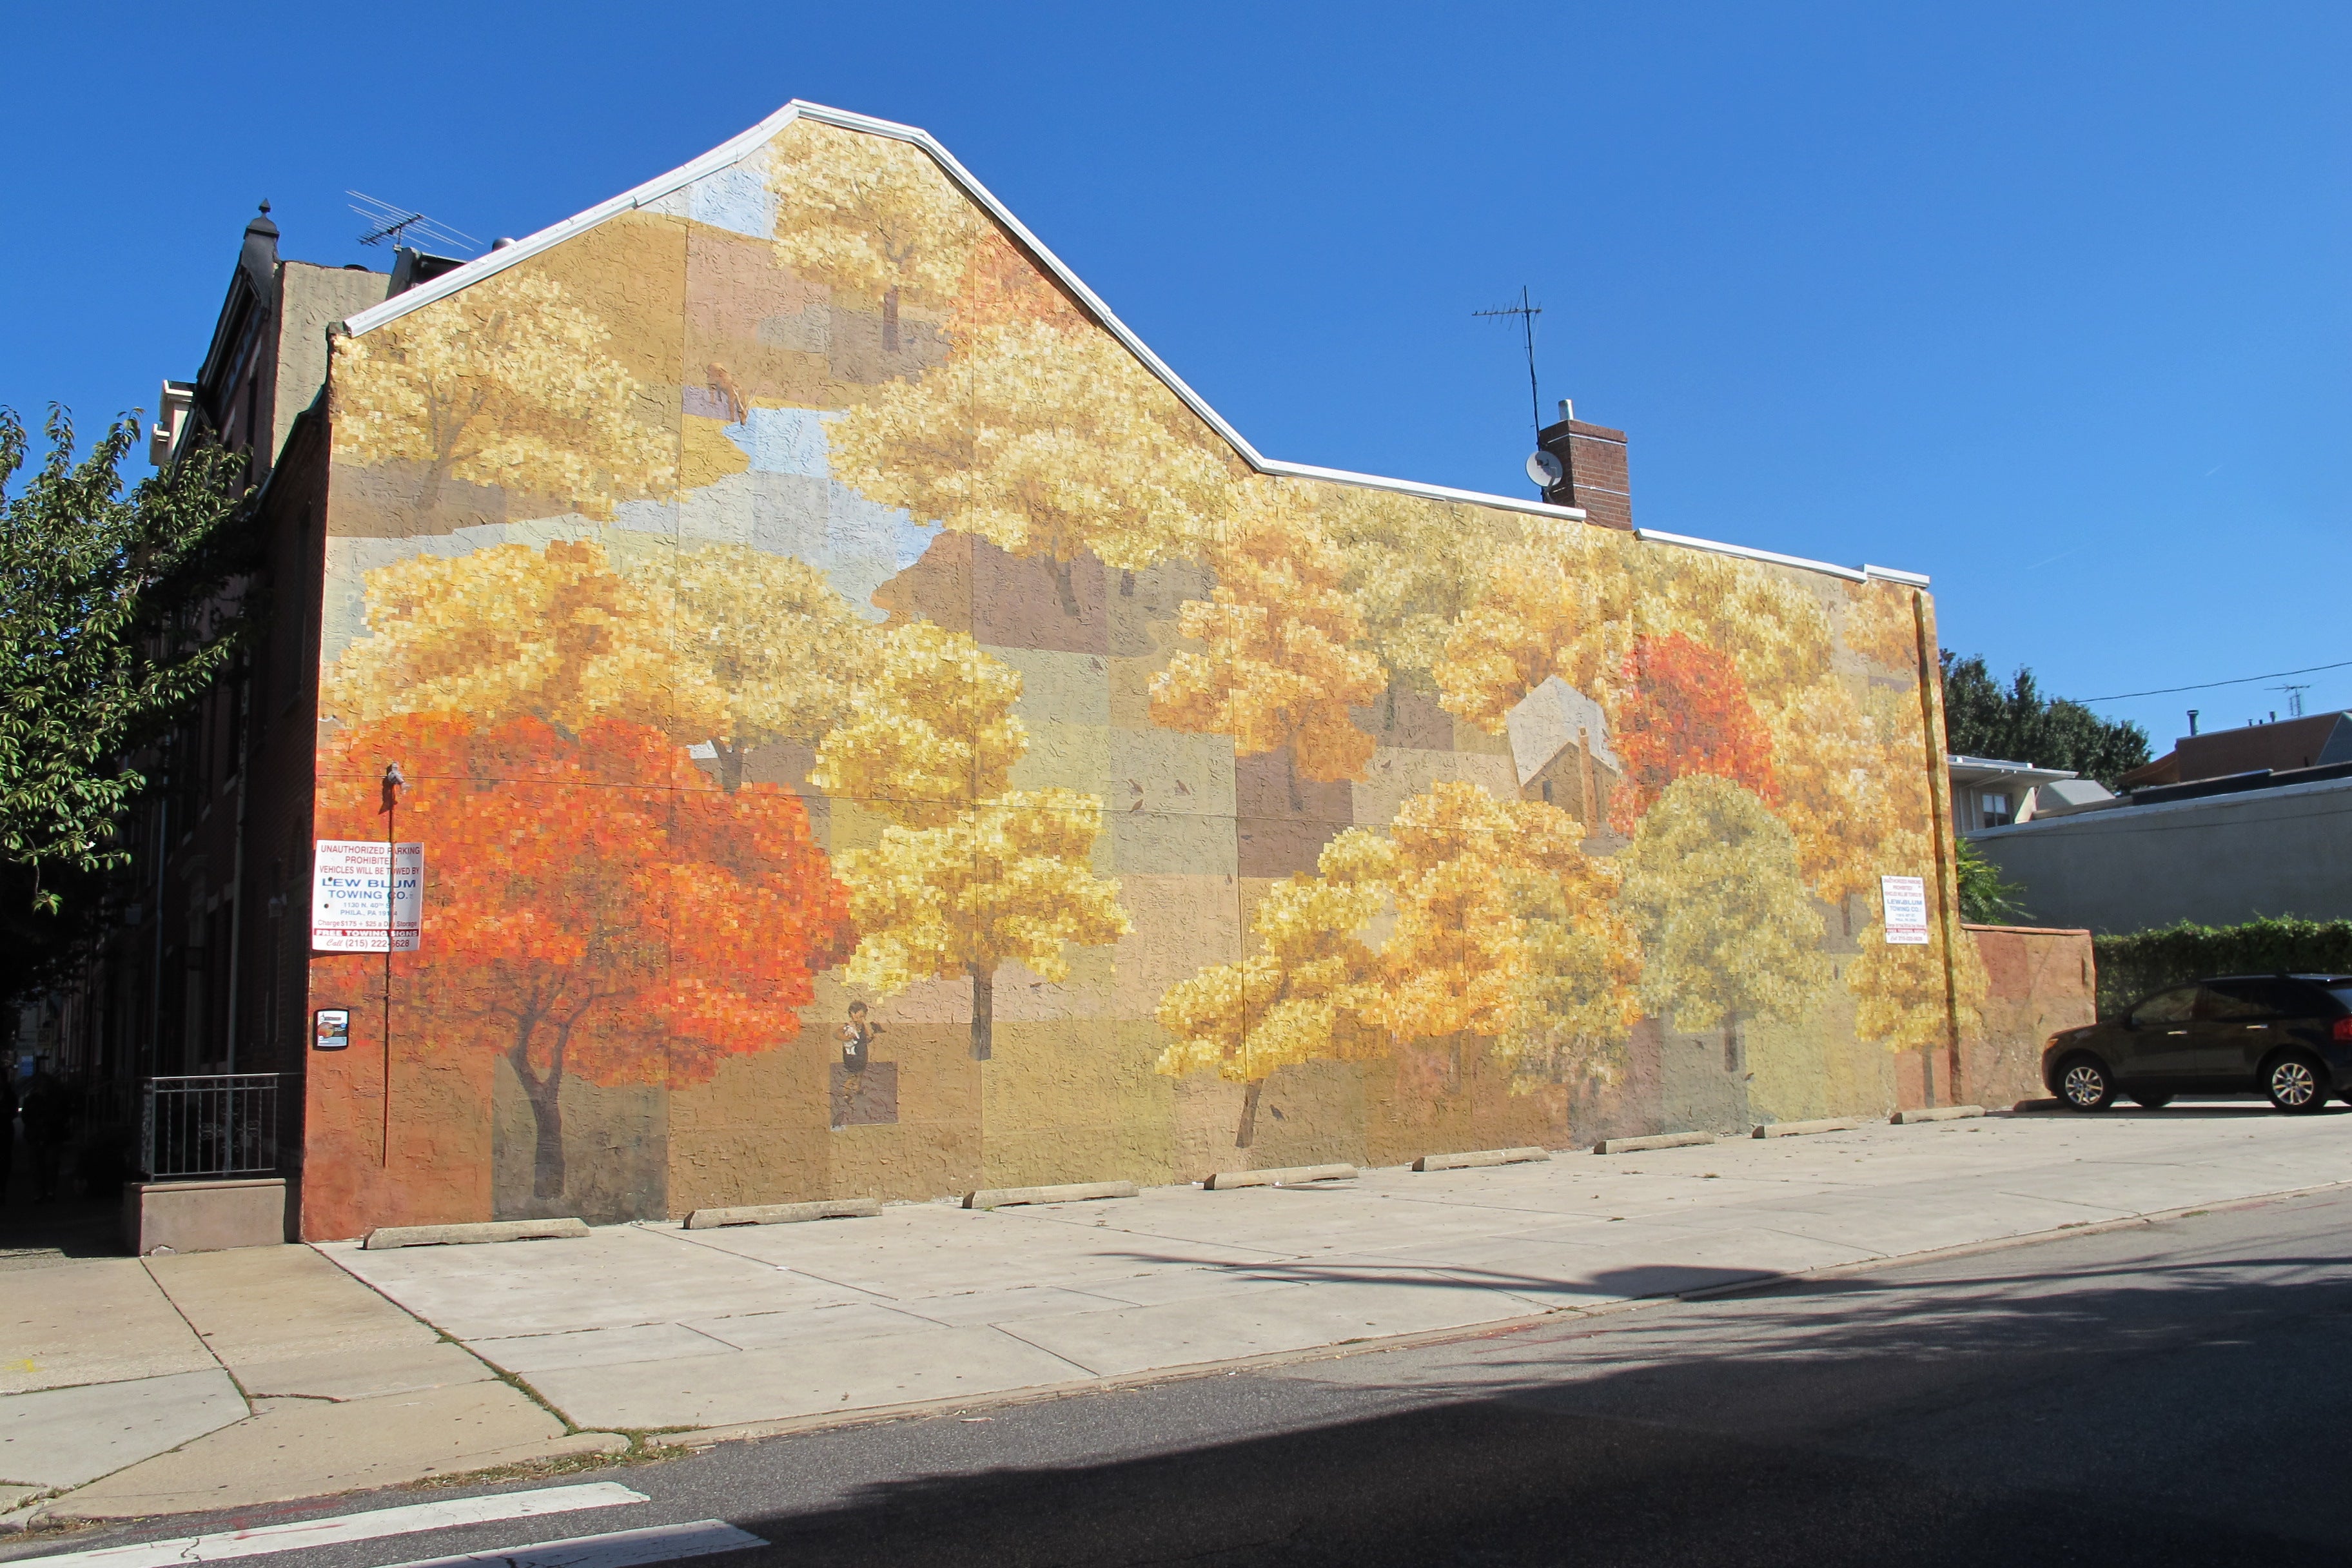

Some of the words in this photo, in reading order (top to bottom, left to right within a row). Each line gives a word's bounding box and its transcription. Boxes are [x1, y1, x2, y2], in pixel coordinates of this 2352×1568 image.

[321, 845, 384, 854] UNAUTHORIZED
[320, 866, 354, 874] VEHICLES
[322, 878, 360, 887] LEW
[328, 890, 382, 899] TOWING
[346, 939, 368, 948] (215)
